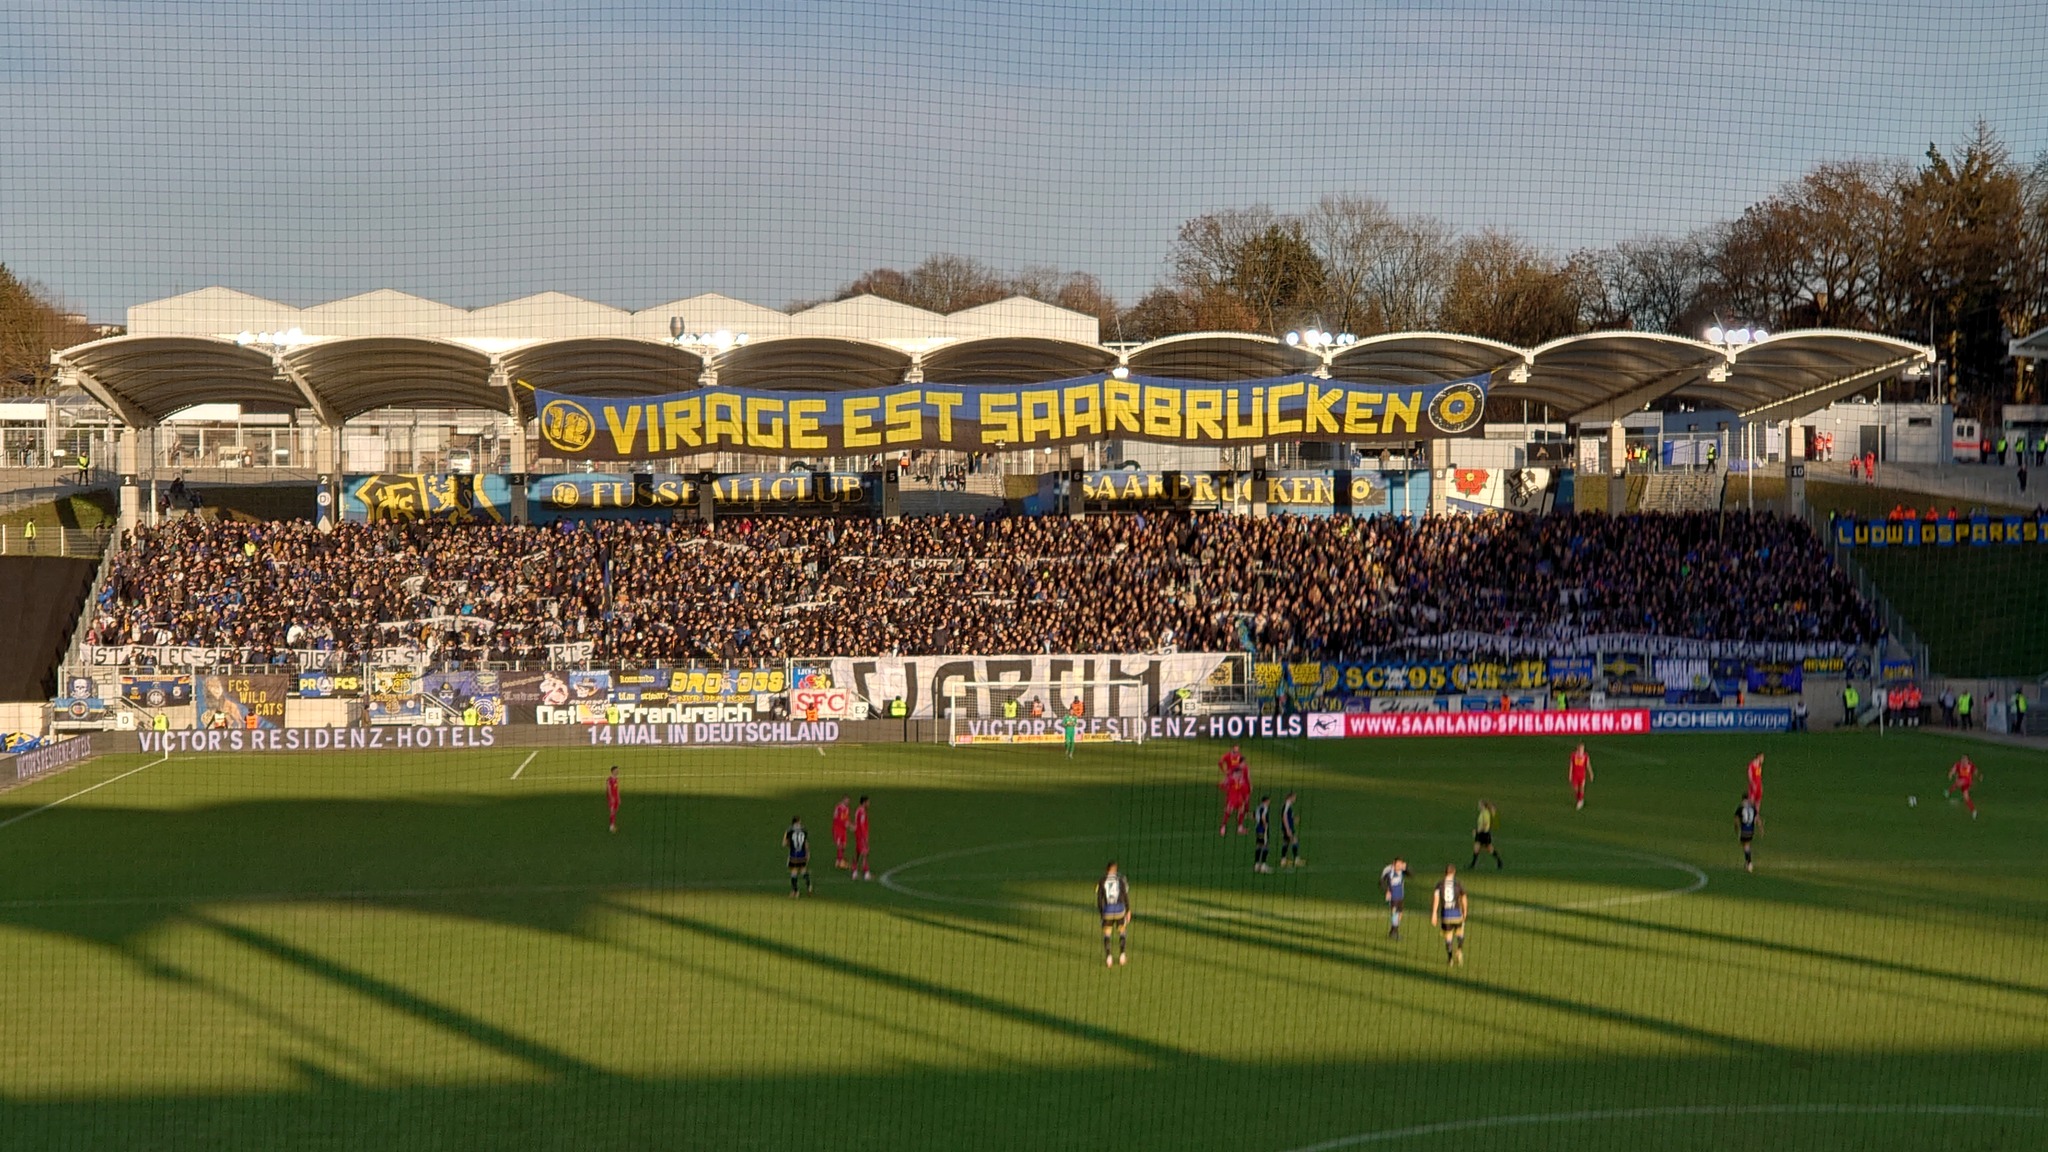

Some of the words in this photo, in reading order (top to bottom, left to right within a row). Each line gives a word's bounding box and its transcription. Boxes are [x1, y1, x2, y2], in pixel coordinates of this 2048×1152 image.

[603, 392, 828, 455] VIRAGE
[842, 389, 964, 449] EST
[979, 380, 1422, 444] SAARBRÜCKEN
[514, 475, 520, 483] 3
[703, 474, 709, 482] 4
[889, 473, 895, 481] 5
[1256, 471, 1263, 479] 7
[1436, 471, 1443, 479] 8
[1792, 468, 1804, 477] 10
[320, 475, 328, 484] 2
[334, 677, 358, 691] FCS
[1346, 666, 1385, 690] SC
[1408, 666, 1446, 690] 95
[228, 679, 250, 692] FCS
[852, 659, 1162, 719] WARUM
[239, 691, 266, 704] WILD
[796, 692, 845, 712] SFC
[255, 703, 283, 716] CATS
[616, 702, 753, 724] Frankreich
[855, 706, 867, 714] E2
[1183, 702, 1196, 711] E3
[122, 716, 129, 725] D
[428, 712, 440, 720] E1
[1349, 711, 1643, 733] WWW.SAARLAND-SPIELBANKEN.DE
[1744, 711, 1789, 729] Gruppe
[588, 726, 612, 746] 14
[618, 725, 660, 745] MAL
[668, 724, 689, 744] IN
[695, 720, 839, 744] DEUTSCHLAND
[968, 717, 1070, 738] VICTOR'S
[1076, 715, 1302, 738] RESIDENZ-HOTELS
[138, 729, 243, 752] VICTOR'S
[251, 726, 495, 750] RESIDENZ-HOTELS
